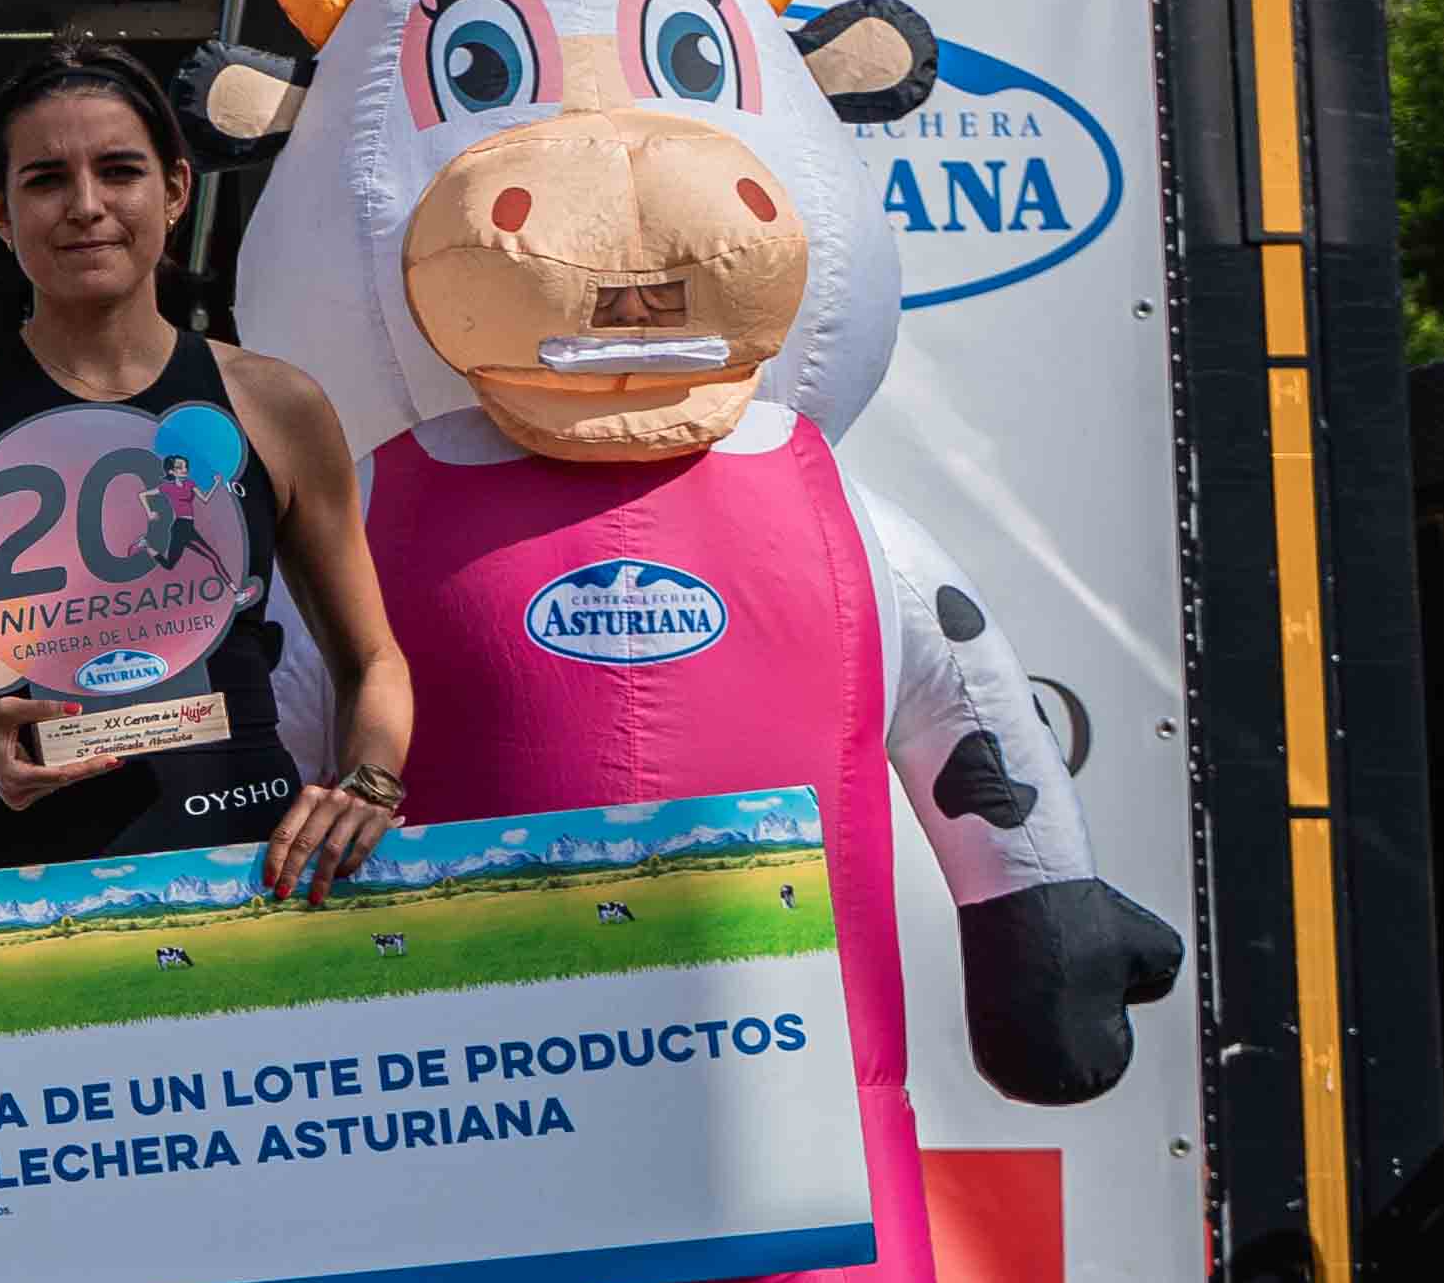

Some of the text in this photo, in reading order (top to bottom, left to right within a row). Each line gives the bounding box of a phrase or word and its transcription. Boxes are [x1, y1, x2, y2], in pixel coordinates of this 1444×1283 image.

[13, 614, 216, 661] CARRERA DE LA MUJER
[542, 598, 713, 637] ASTURIANA
[84, 664, 161, 688] ASTURIANA
[184, 776, 291, 818] OYSHO
[42, 1082, 111, 1126] DE
[130, 1072, 205, 1116] UN
[224, 1056, 363, 1108] LOTE
[377, 1049, 446, 1092] DE
[465, 1012, 807, 1084] PRODUCTOS
[256, 1096, 576, 1165] ASTURIANA
